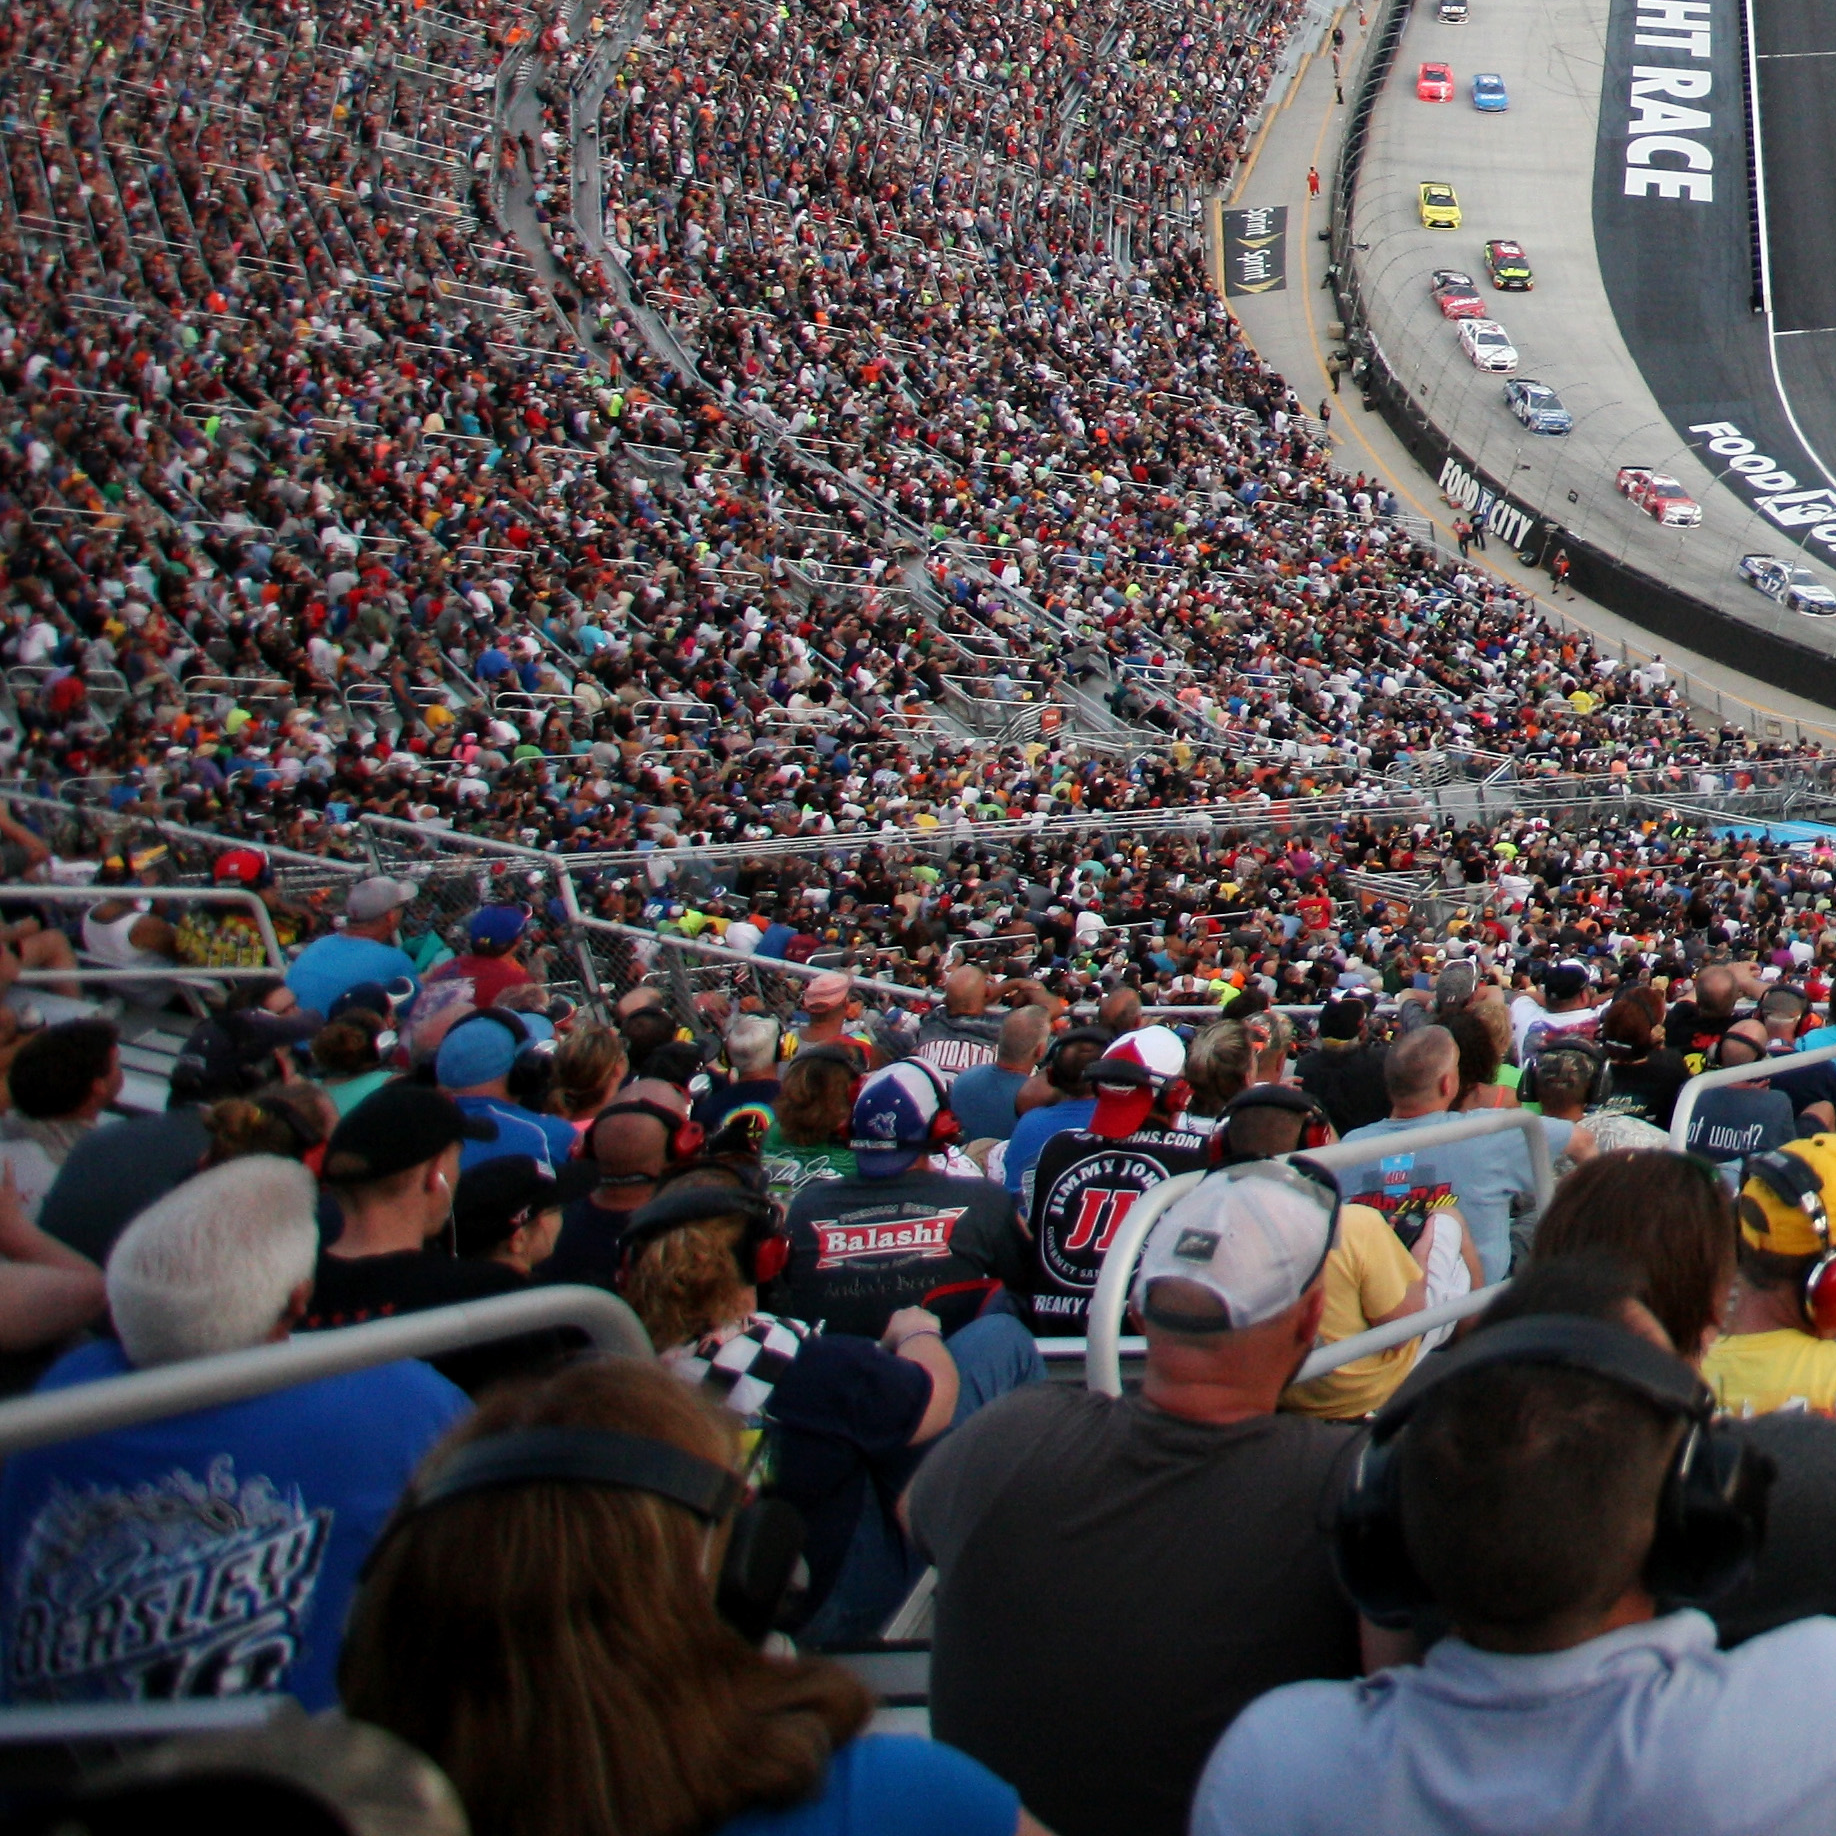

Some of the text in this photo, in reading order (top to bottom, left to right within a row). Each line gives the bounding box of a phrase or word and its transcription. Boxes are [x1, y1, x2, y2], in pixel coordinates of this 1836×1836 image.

[1624, 65, 1713, 203] RACE
[1241, 207, 1274, 237] Sprint
[1236, 249, 1271, 281] Sprint
[1689, 421, 1799, 492] FOOD
[1438, 457, 1534, 550] FOOD CITY
[1764, 577, 1782, 593] 17
[1709, 1124, 1763, 1151] wood?
[1050, 1157, 1116, 1217] JIMMY
[826, 1222, 946, 1254] Balashi
[1034, 1294, 1086, 1314] REAKY
